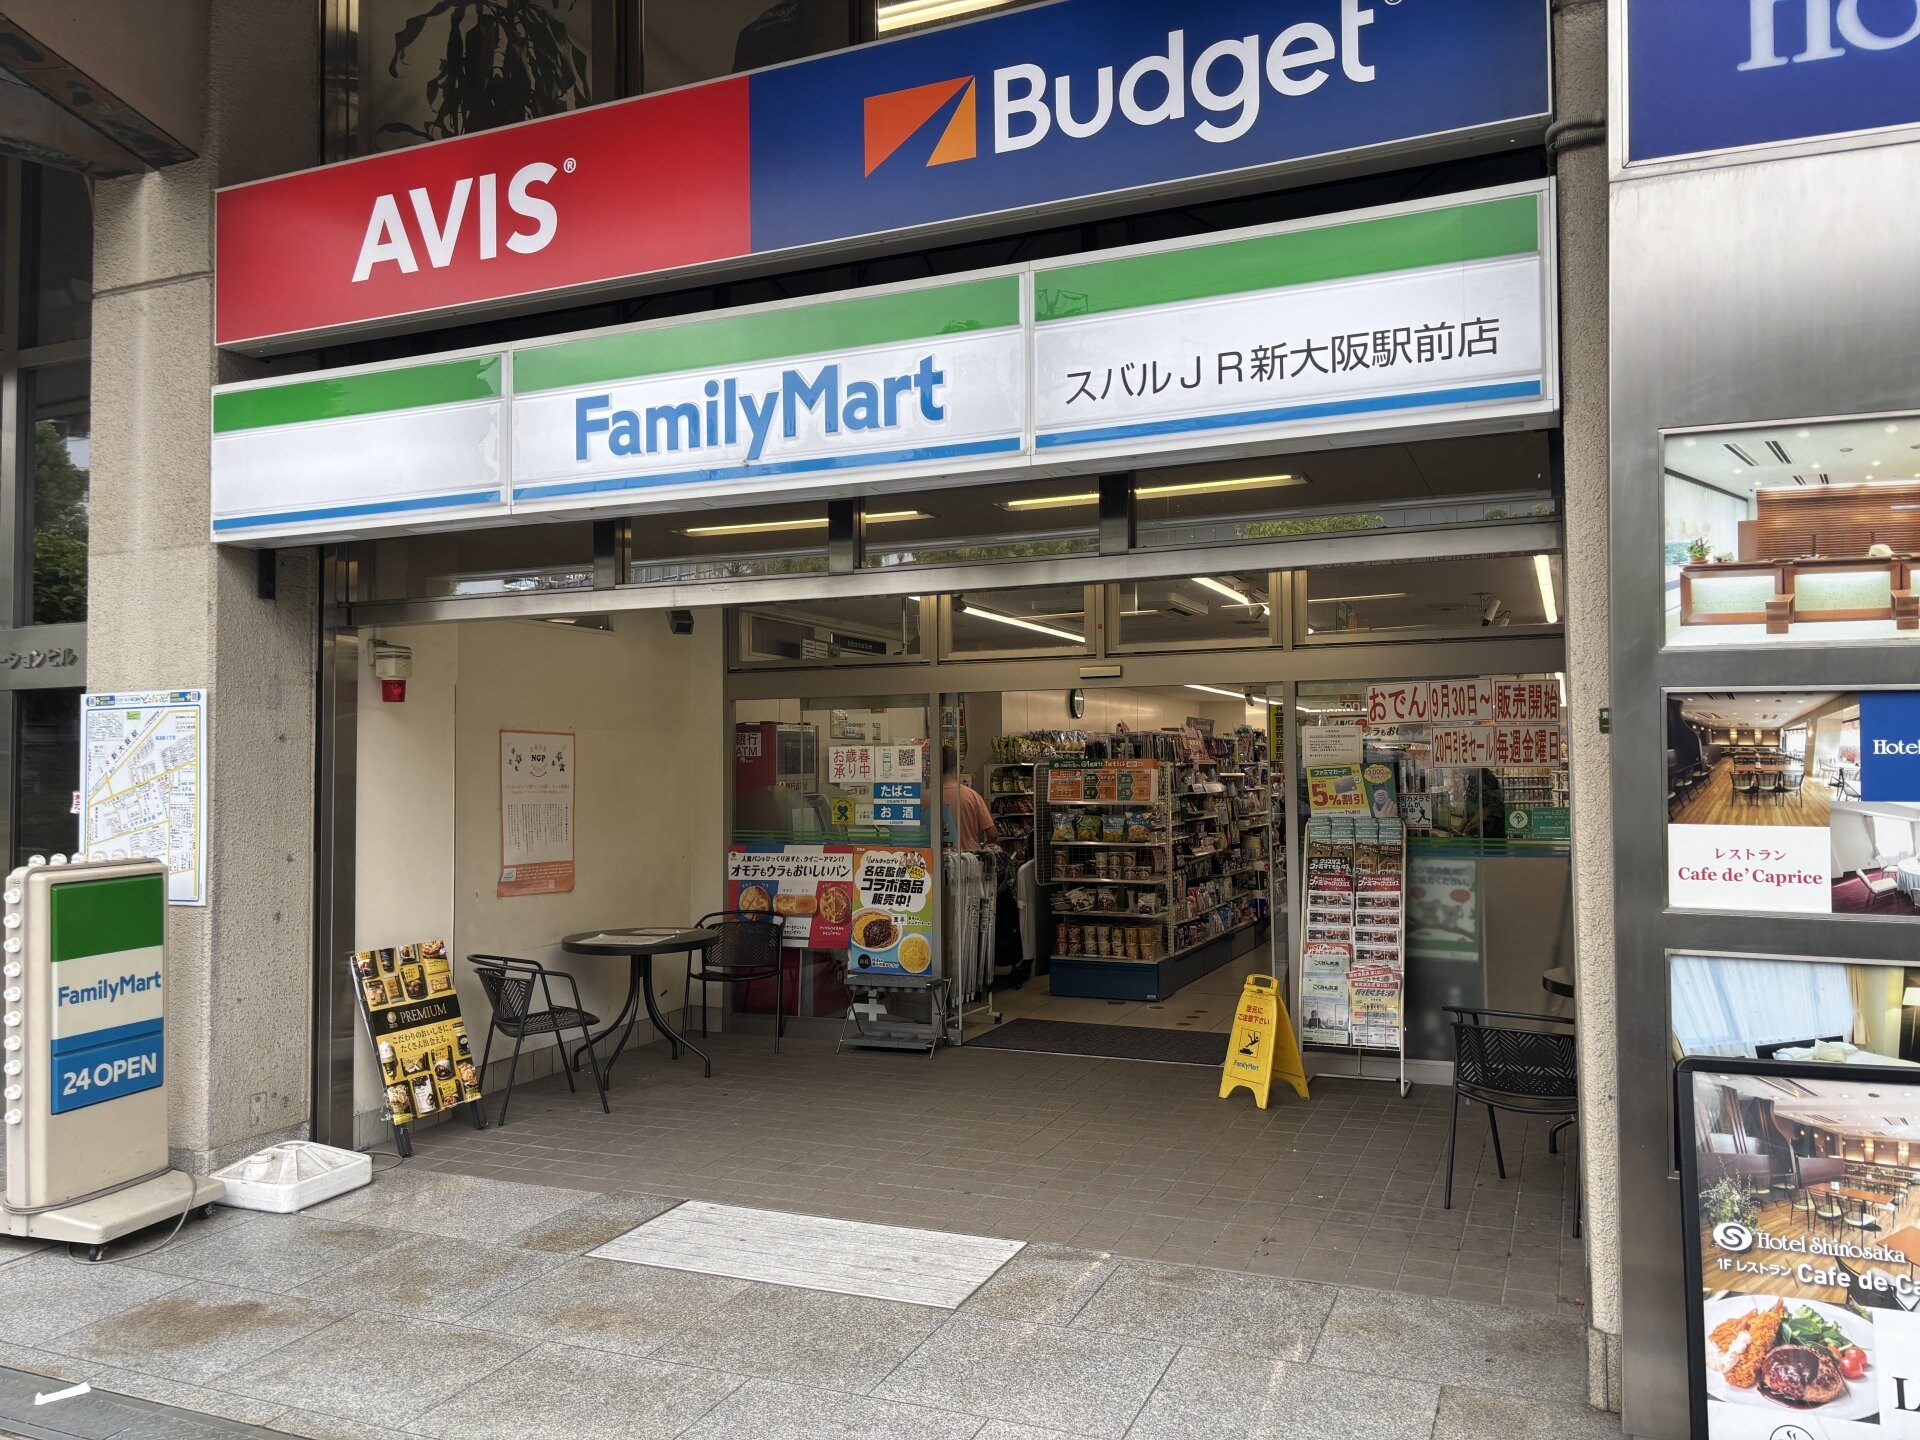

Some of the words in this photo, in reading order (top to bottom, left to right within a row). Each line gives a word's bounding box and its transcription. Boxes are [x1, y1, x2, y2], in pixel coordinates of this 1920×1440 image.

[993, 0, 1375, 143] Budget
[573, 354, 947, 464] FamilyMart
[1368, 686, 1427, 723] おでん
[1496, 683, 1558, 719] 販売開始
[736, 733, 758, 746] 銀行
[1433, 729, 1494, 764] 20円引きセール
[1495, 729, 1560, 764] 毎週金曜日
[531, 754, 546, 762] NGP
[736, 746, 758, 756] ATM
[833, 748, 871, 763] お歳暮
[833, 763, 870, 779] 承り中
[880, 785, 913, 797] たばこ
[1714, 847, 1787, 862] レストラン
[731, 864, 851, 878] オモテもウラもおいしいパン
[864, 865, 907, 878] 名店監修
[1677, 866, 1718, 882] Cafe
[1751, 868, 1823, 887] Caprice
[860, 878, 925, 894] コラボ商品
[871, 893, 911, 907] 販売中!
[57, 970, 162, 1007] FamilyMart
[400, 1003, 447, 1023] PREMIUM
[1246, 1005, 1263, 1014] 足元に
[1237, 1013, 1270, 1025] ご注意下さい
[393, 1025, 452, 1042] こだわりのおいしさに、
[401, 1038, 449, 1053] たくさん出会える。
[1234, 1060, 1260, 1071] FamilyMart
[62, 1069, 91, 1097] 24
[93, 1052, 157, 1089] OPEN
[1757, 1232, 1807, 1254] Hotel
[1717, 1257, 1732, 1271] 1F
[1736, 1259, 1793, 1277] レストラン
[1797, 1263, 1851, 1289] Cafe
